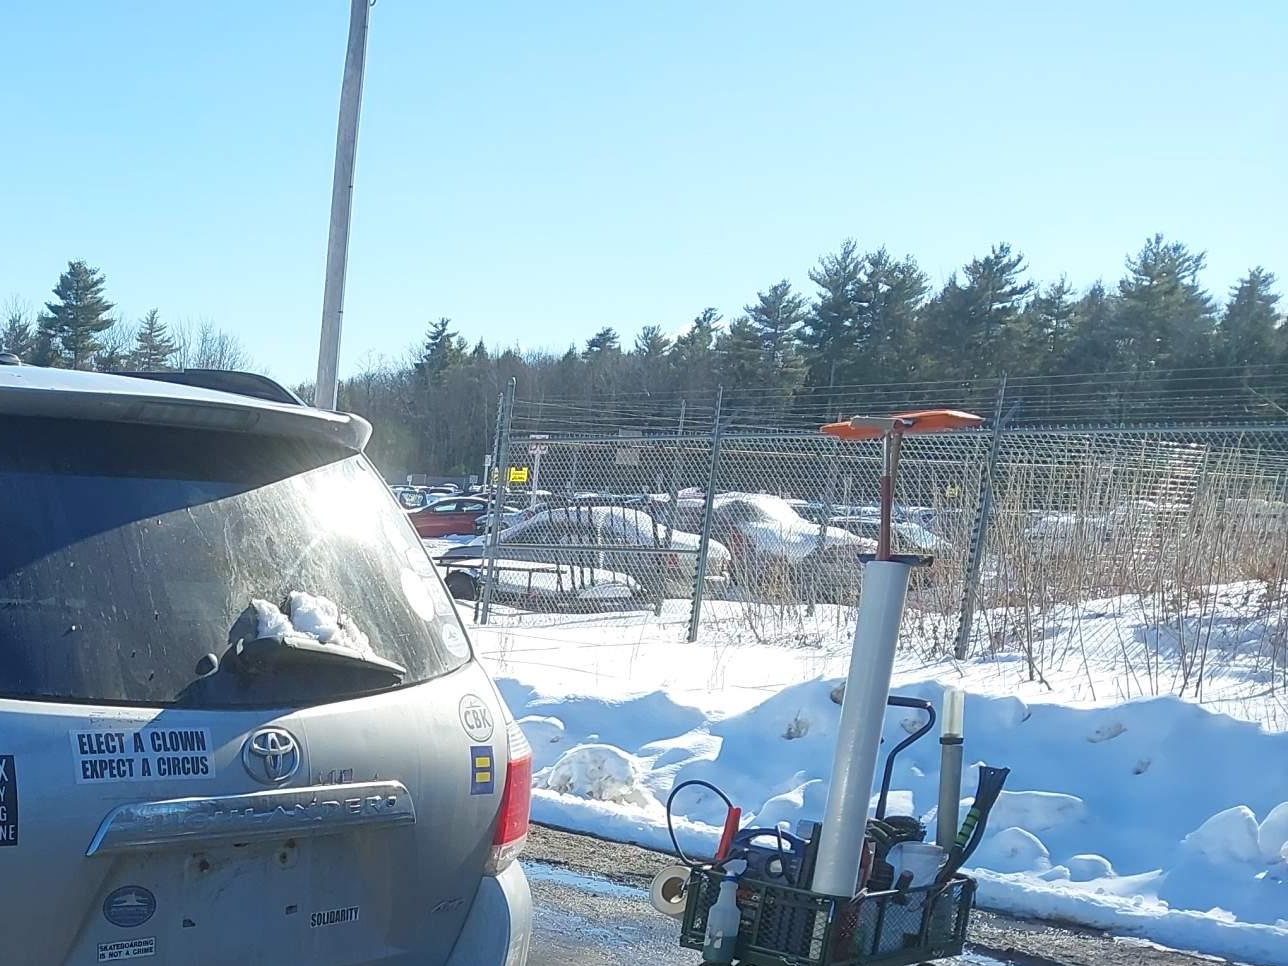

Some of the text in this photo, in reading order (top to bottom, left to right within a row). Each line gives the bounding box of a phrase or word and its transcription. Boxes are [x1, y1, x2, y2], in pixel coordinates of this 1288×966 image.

[464, 709, 491, 730] CBK
[77, 730, 207, 755] ELECT A CLOWN
[81, 756, 209, 779] EXPECT A CIRCUS
[310, 907, 360, 928] SOLIDARITY
[99, 938, 154, 952] SKATEBOARDING
[99, 952, 106, 960] IS
[109, 950, 122, 959] NOT
[132, 946, 154, 956] CRIME
